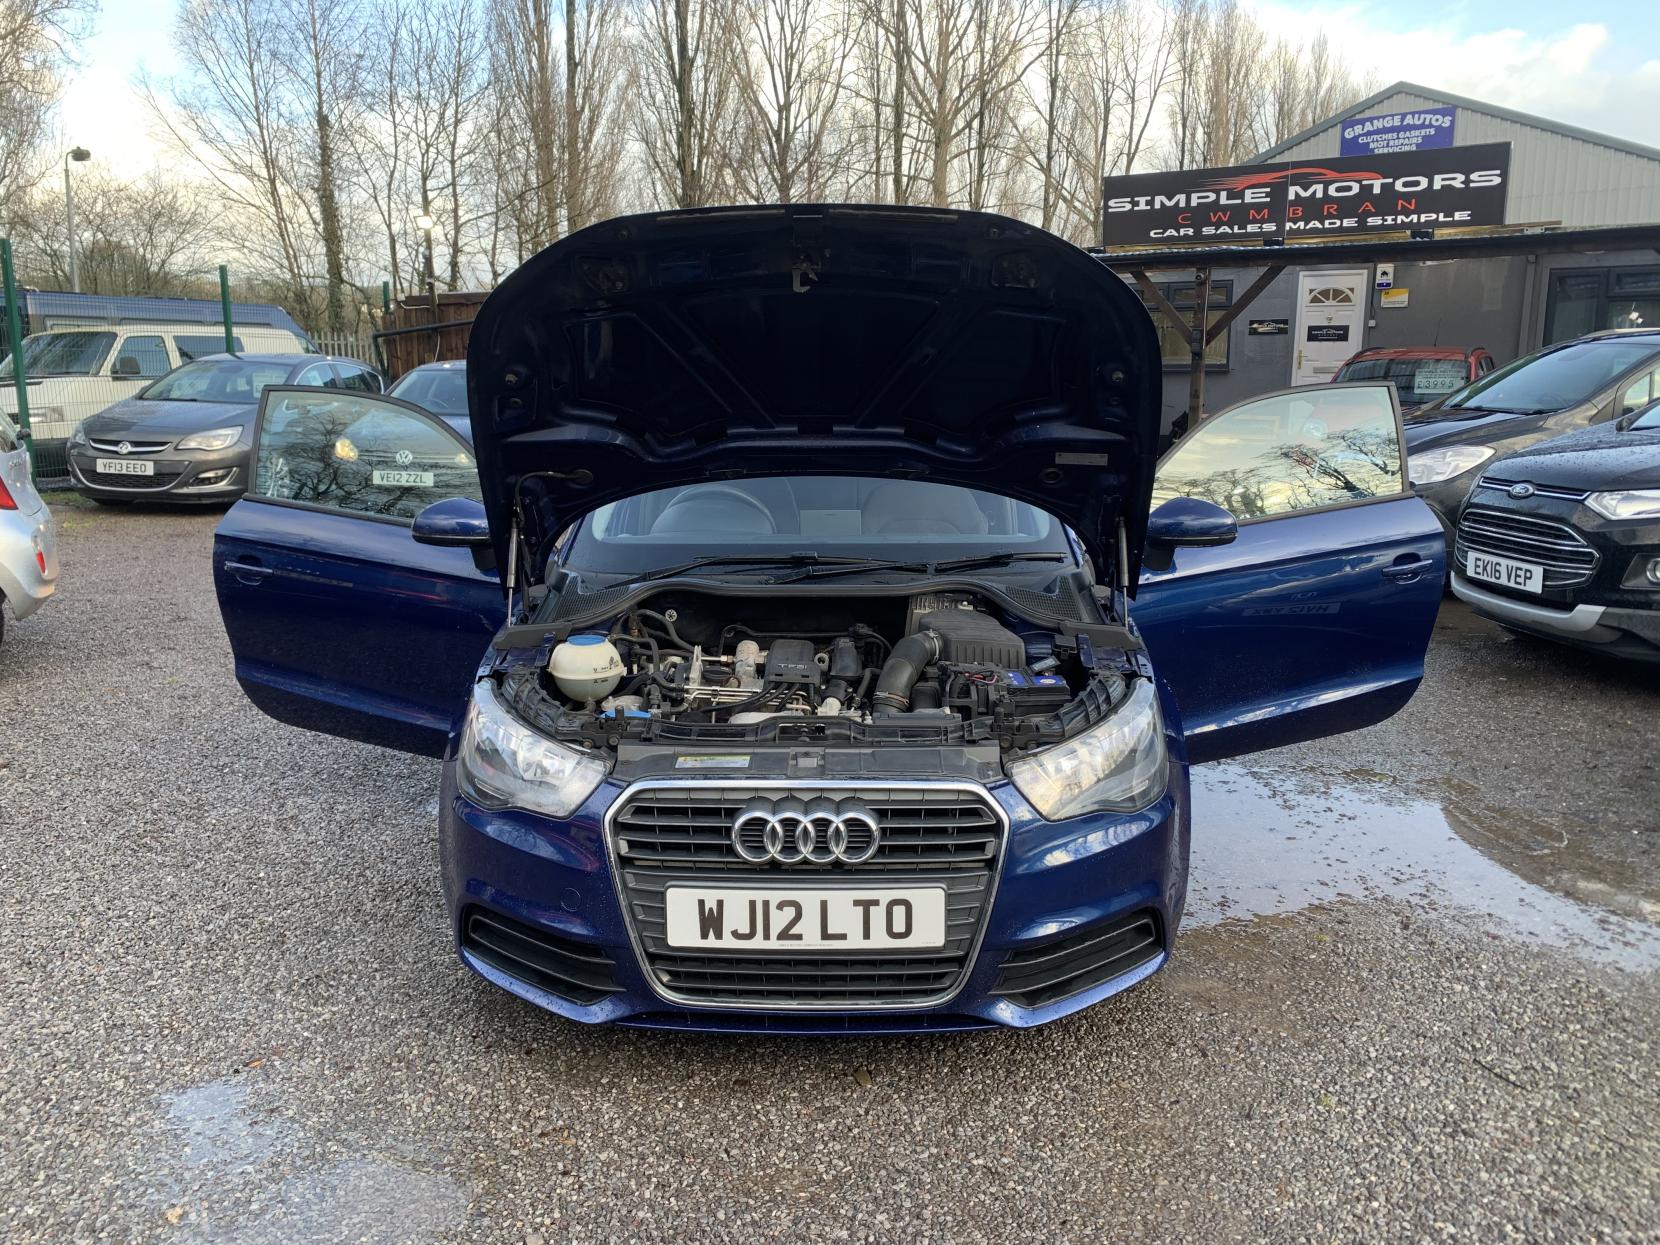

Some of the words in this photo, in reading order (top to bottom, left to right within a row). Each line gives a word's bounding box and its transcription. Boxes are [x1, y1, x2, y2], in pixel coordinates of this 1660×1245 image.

[1344, 115, 1401, 138] GRANGE
[1403, 114, 1452, 127] AUTOS
[1358, 132, 1397, 143] CLUTCHES
[1399, 128, 1436, 138] GASKETS
[1369, 141, 1387, 149] MOT
[1388, 137, 1423, 146] REPAIRS
[1374, 144, 1416, 154] SERVICING
[1107, 188, 1271, 212] SIMPLE
[1288, 170, 1502, 200] MOTORS
[1178, 198, 1416, 224] CWMBRAN
[1150, 228, 1194, 238] CAR
[1201, 223, 1277, 235] SALES
[1286, 217, 1358, 230] MADE
[1366, 211, 1472, 226] SIMPLE
[102, 461, 124, 473] YF13
[125, 463, 147, 473] EEO
[380, 472, 402, 483] VE12
[405, 473, 427, 484] ZZL
[1474, 557, 1502, 580] EK16
[1506, 564, 1533, 587] VEP
[697, 898, 803, 942] WJ12
[819, 898, 913, 942] LTO
